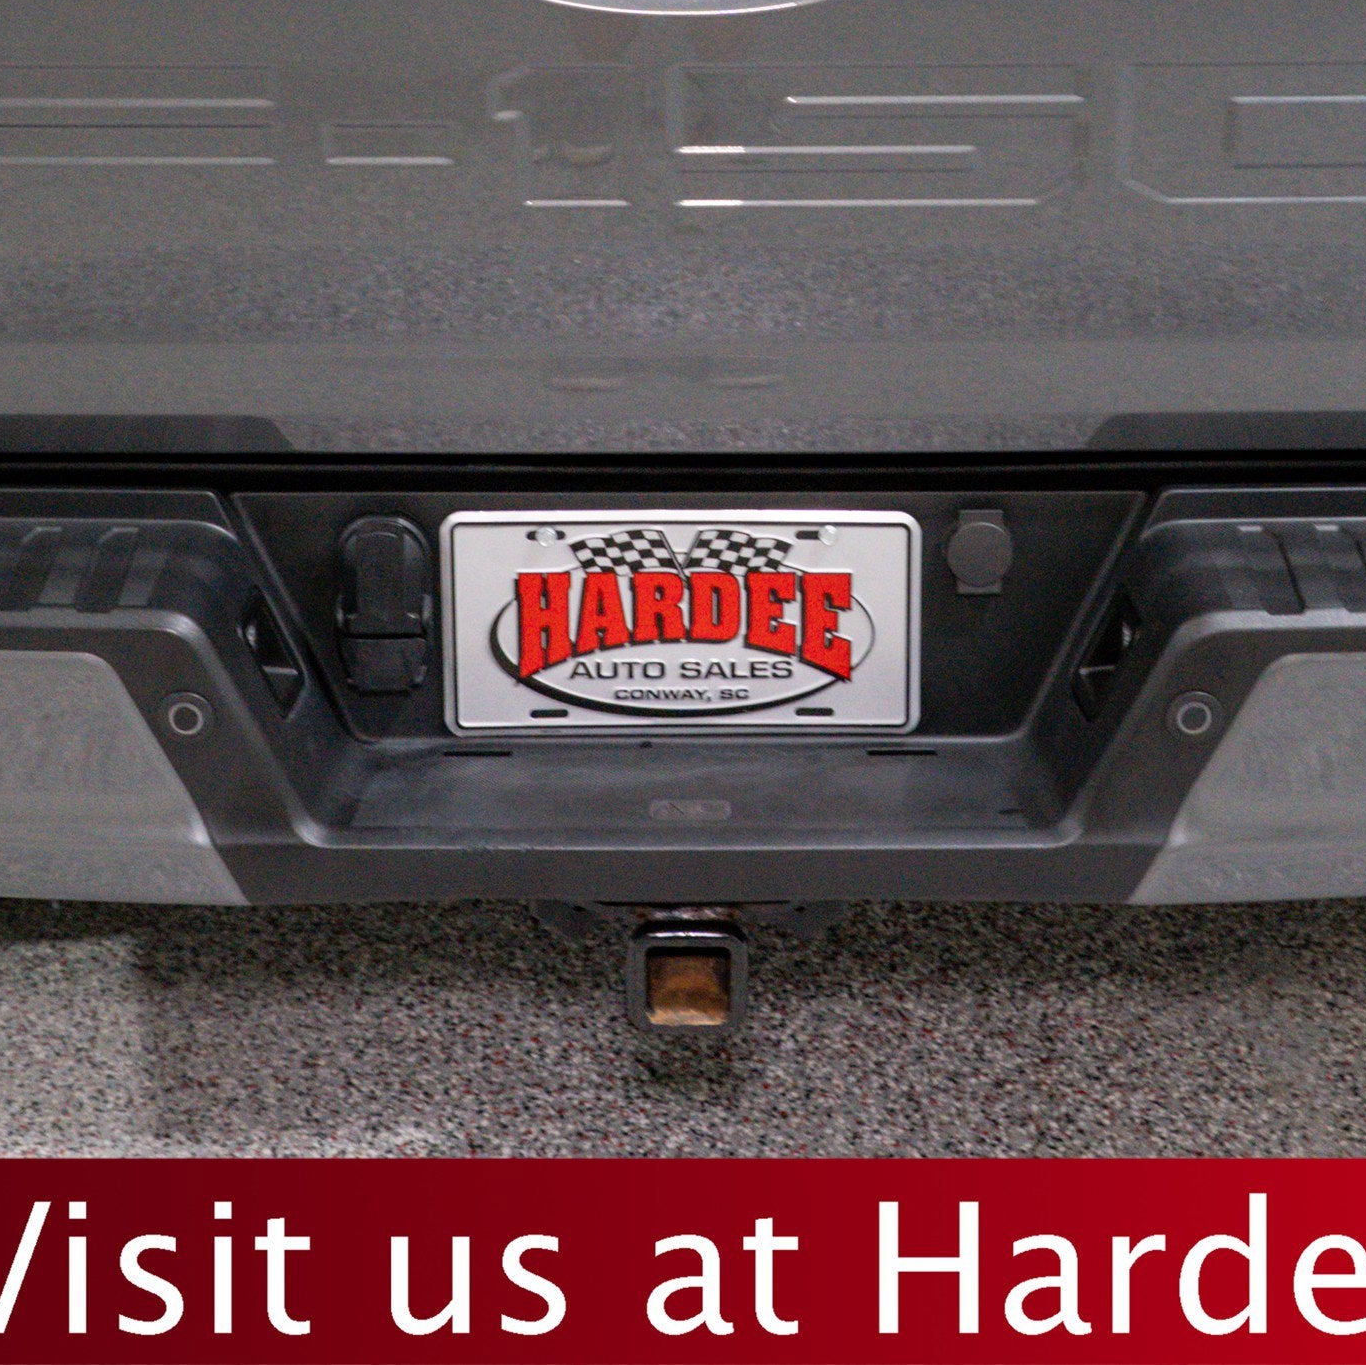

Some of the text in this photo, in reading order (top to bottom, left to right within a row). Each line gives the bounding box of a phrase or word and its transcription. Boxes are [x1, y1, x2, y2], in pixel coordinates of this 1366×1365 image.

[515, 571, 852, 682] HARDEE
[570, 661, 793, 680] AUTO SALES
[614, 689, 750, 702] CONWAY, SC
